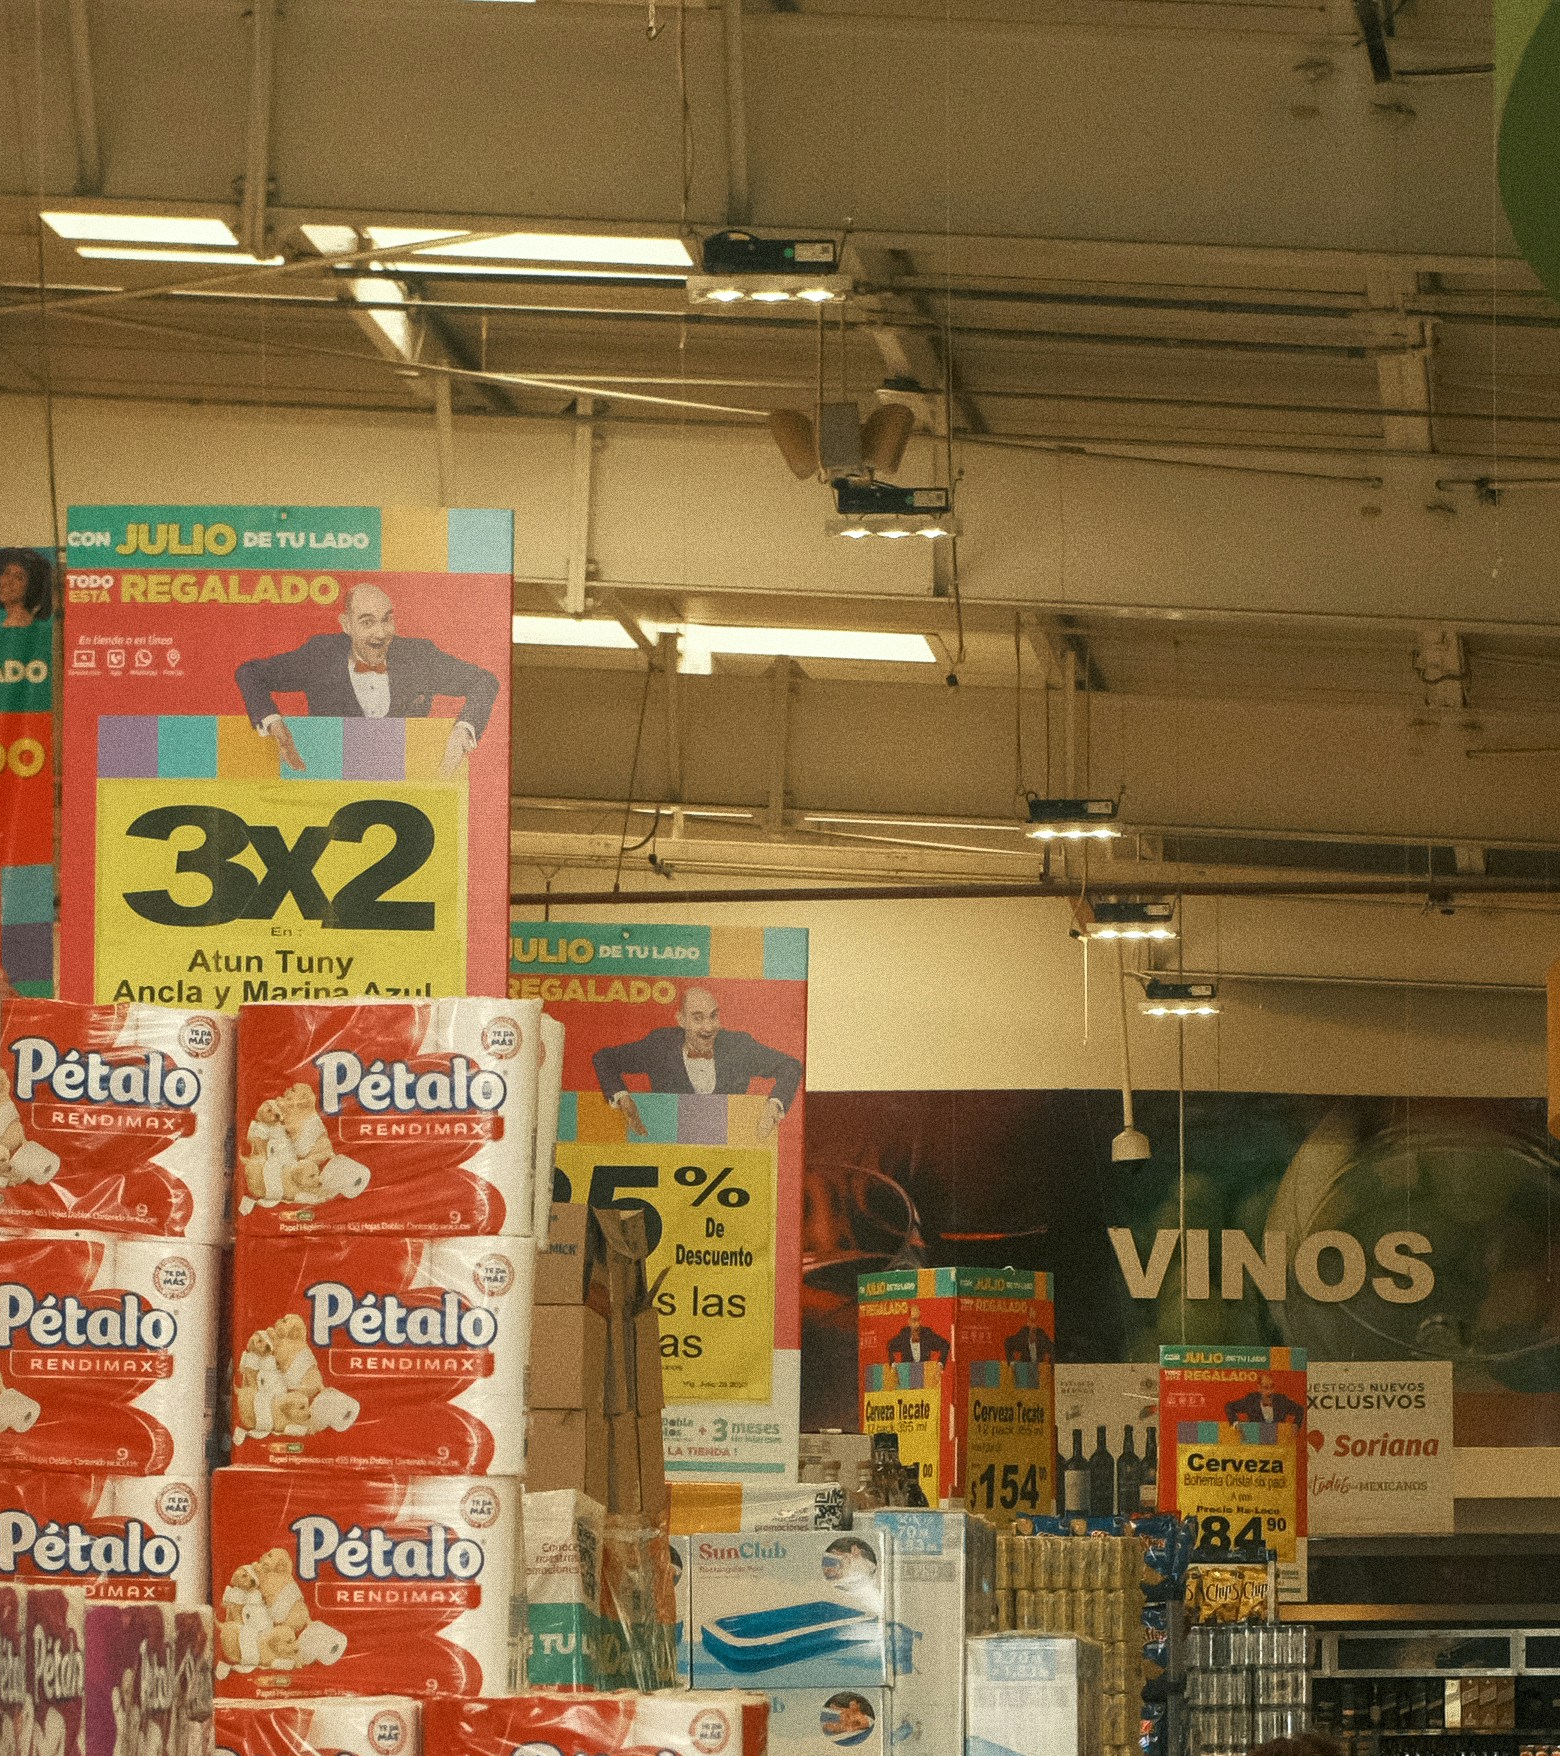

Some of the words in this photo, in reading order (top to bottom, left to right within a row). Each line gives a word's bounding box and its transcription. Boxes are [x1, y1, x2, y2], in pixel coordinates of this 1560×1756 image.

[68, 532, 111, 547] CON
[116, 523, 237, 556] JULIO
[243, 532, 271, 548] DE
[276, 532, 306, 548] TU
[310, 532, 369, 549] LADO
[66, 574, 114, 589] TODO
[121, 574, 340, 606] REGALADO
[124, 800, 436, 931] 3x2
[510, 937, 594, 963] JULIO
[599, 944, 623, 959] DE
[625, 944, 650, 959] TU
[652, 945, 700, 961] LADO
[188, 948, 264, 974] Atun
[273, 949, 354, 982] Tuny
[113, 978, 206, 1004] Ancla
[214, 985, 231, 1009] y
[241, 979, 350, 1000] Marina
[510, 978, 676, 1005] REGALADO
[705, 1218, 725, 1239] De
[675, 1244, 752, 1268] Descuento
[1108, 1227, 1436, 1303] VINOS
[692, 1286, 746, 1318] las
[30, 1358, 153, 1373] RENDIMAX
[350, 1357, 475, 1371] RENDIMAX
[1370, 1382, 1425, 1392] NUEVOS
[866, 1401, 895, 1422] Cerveza
[897, 1399, 930, 1420] Tecate
[974, 1400, 1014, 1423] Cerveza
[1333, 1432, 1439, 1457] Soriana
[1187, 1452, 1284, 1475] Cerveza
[980, 1464, 1040, 1509] 154
[1267, 1517, 1287, 1531] 90
[699, 1541, 786, 1561] SunClub
[425, 1678, 438, 1693] 9
